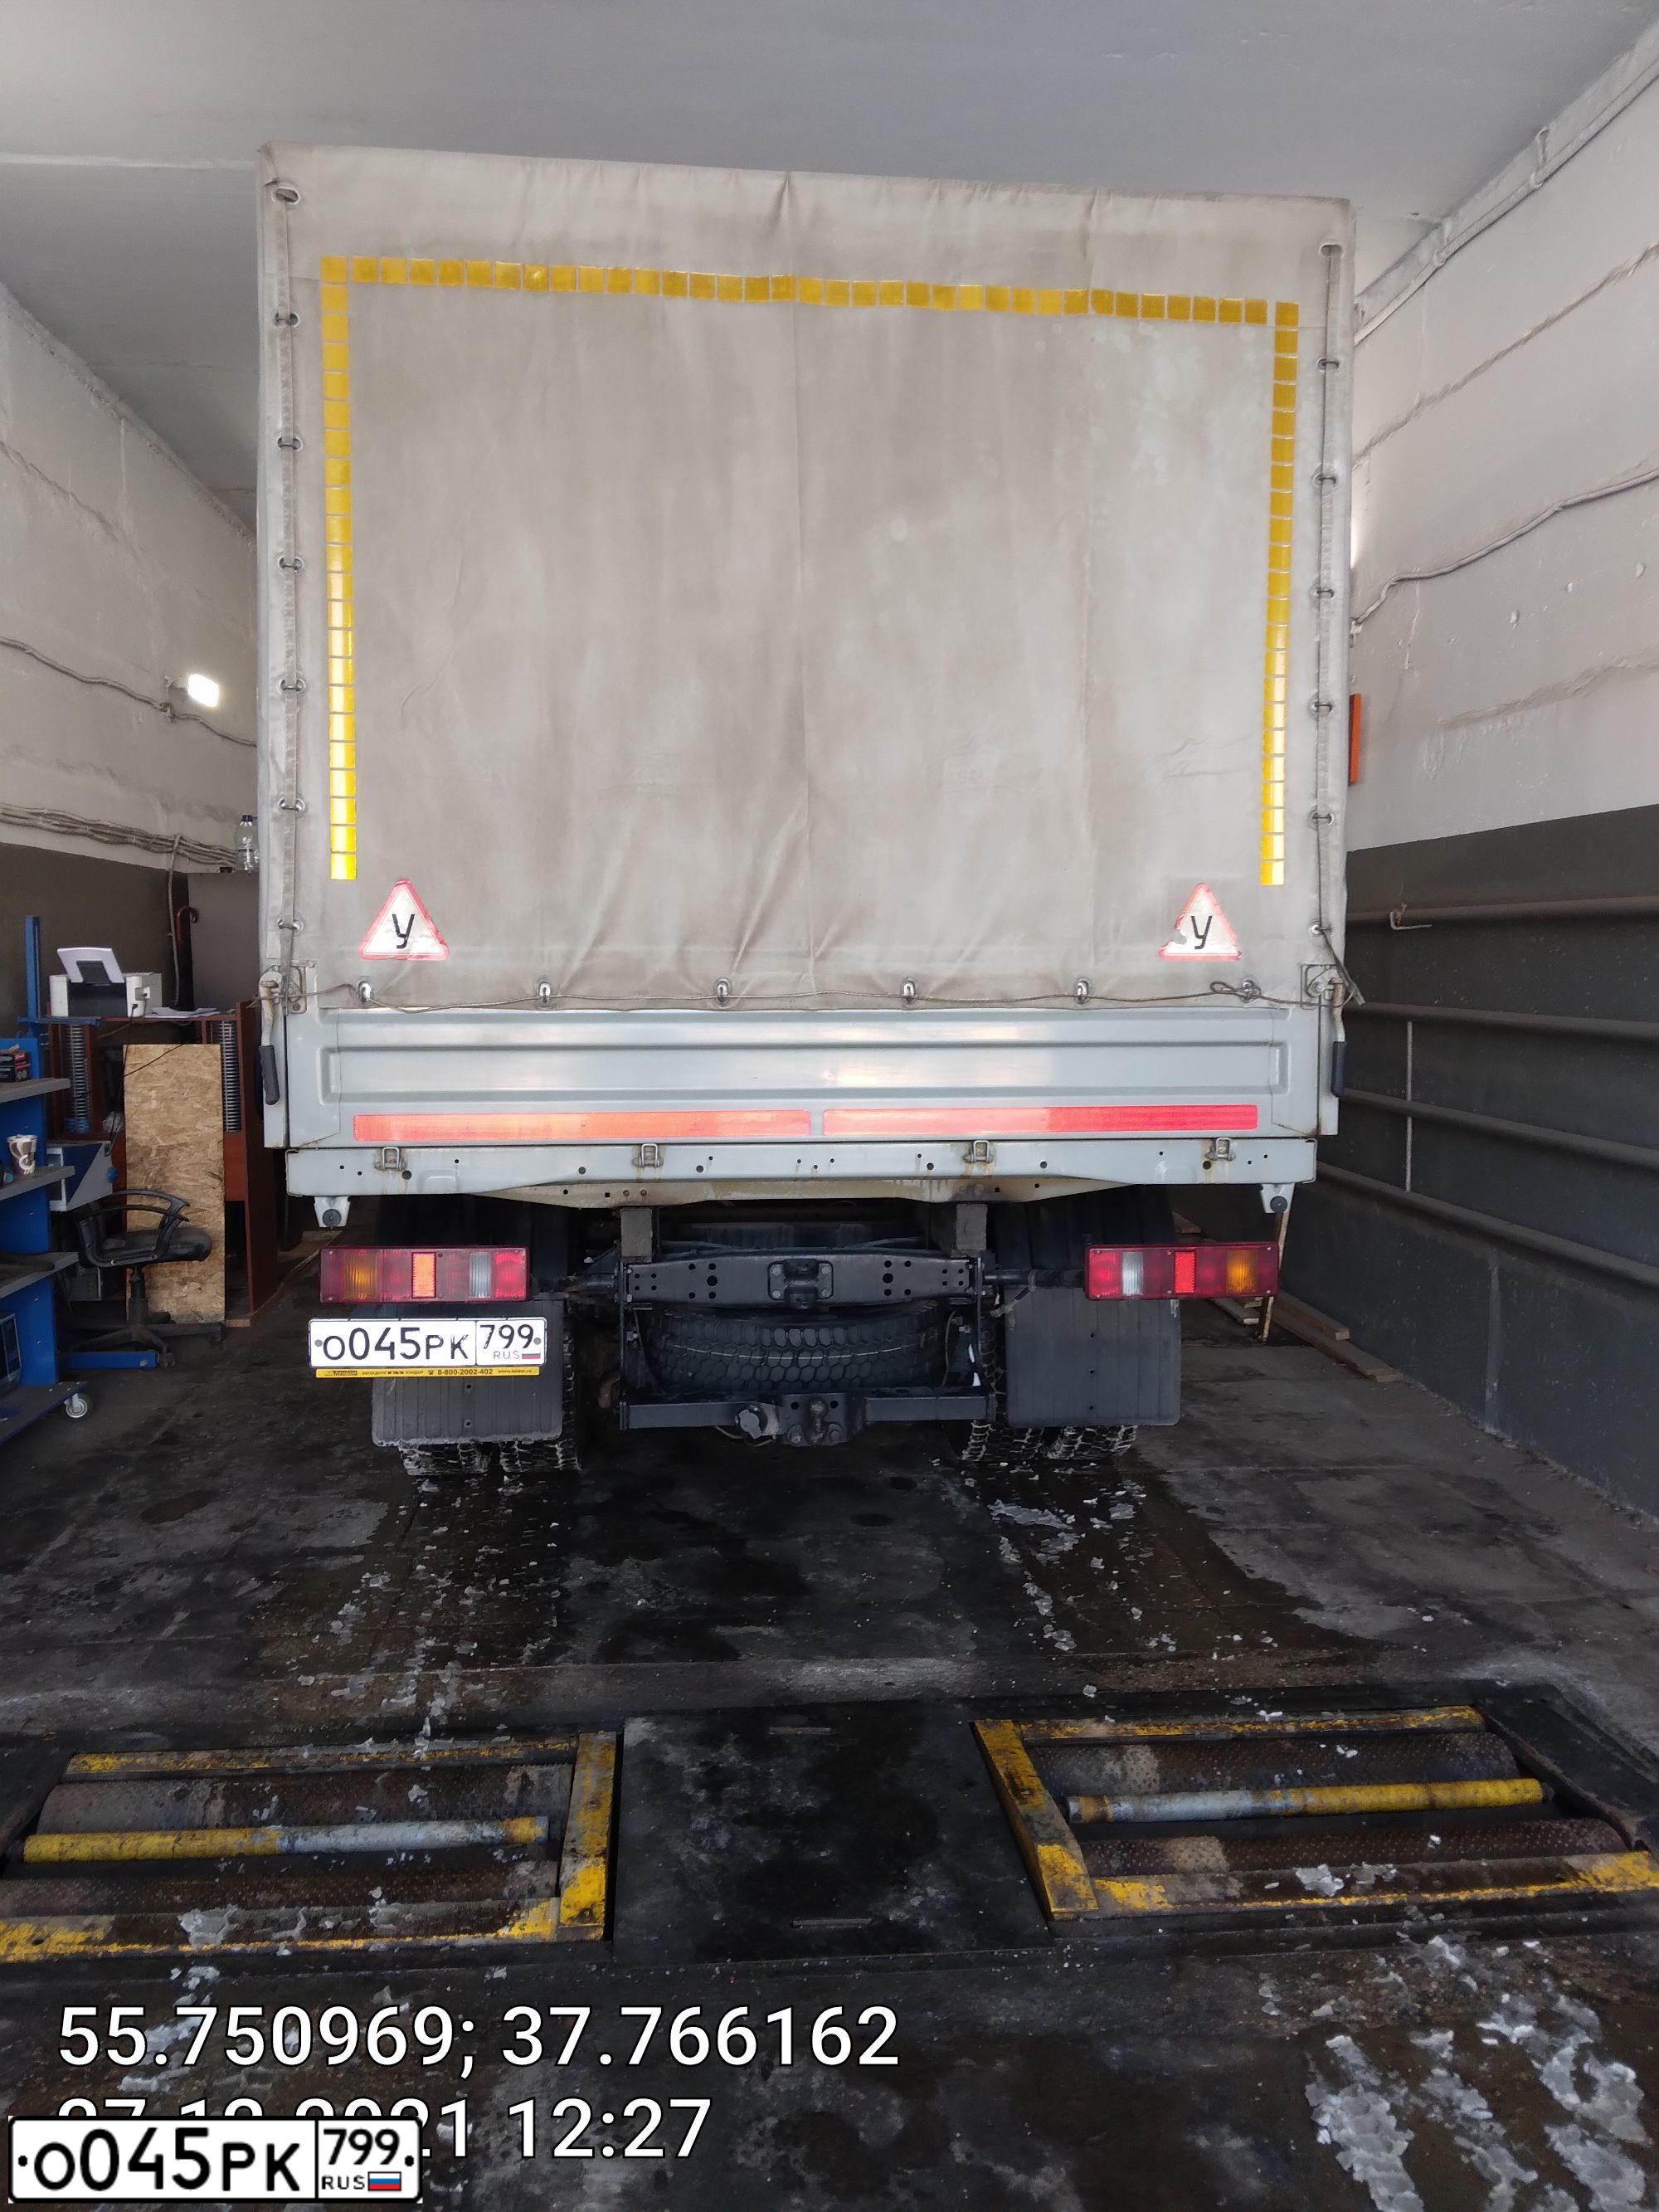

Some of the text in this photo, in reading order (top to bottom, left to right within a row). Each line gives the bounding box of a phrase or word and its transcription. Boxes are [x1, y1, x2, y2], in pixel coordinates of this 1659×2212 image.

[322, 1323, 535, 1361] О045РК 799
[493, 1350, 521, 1361] RUS
